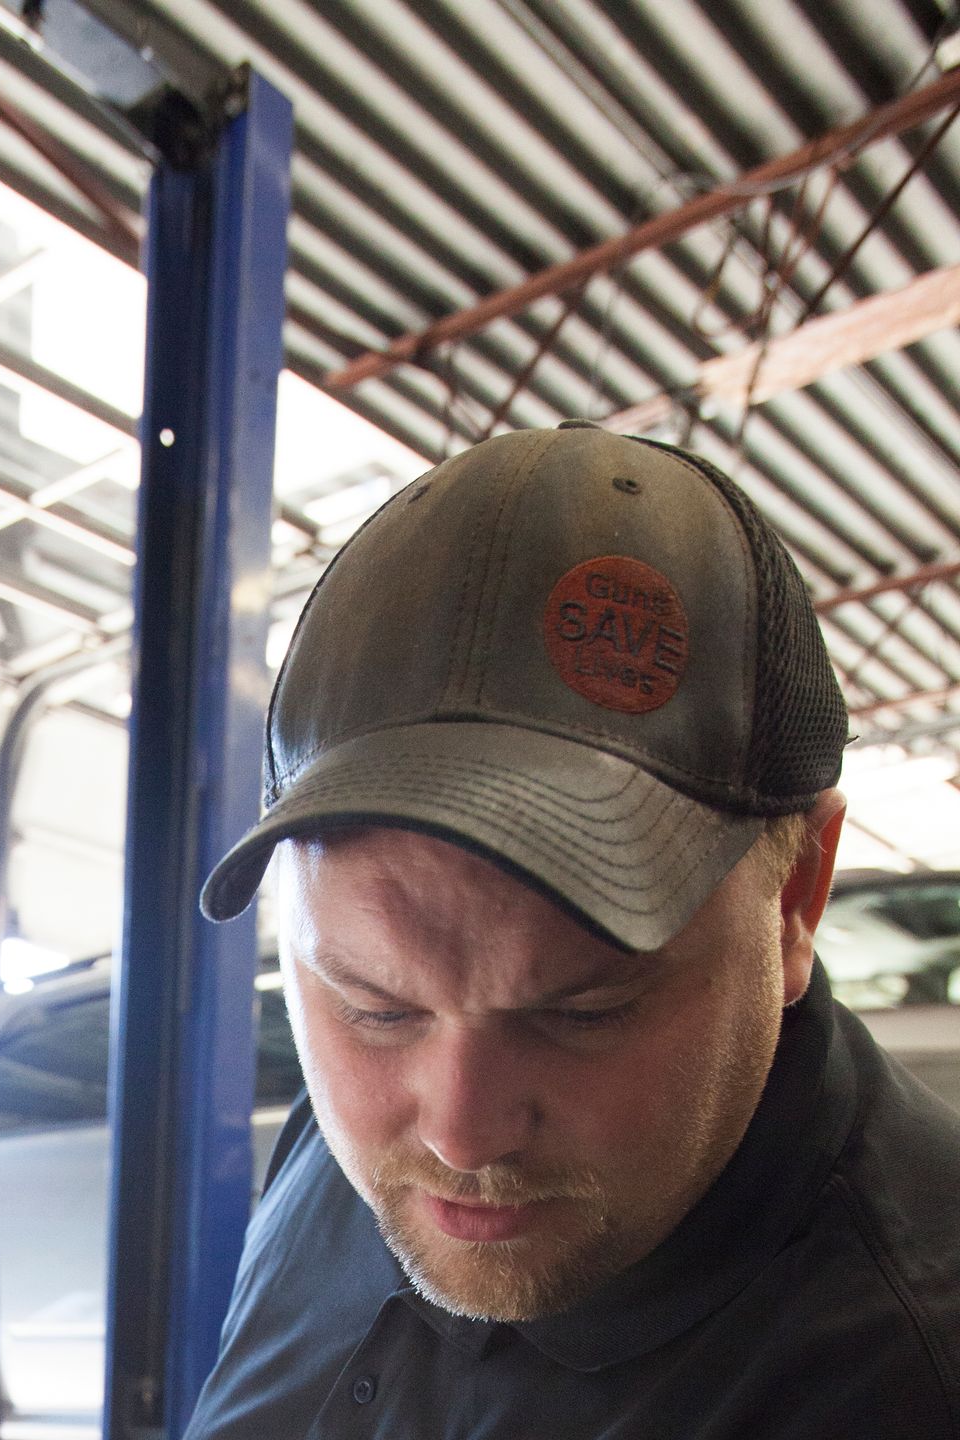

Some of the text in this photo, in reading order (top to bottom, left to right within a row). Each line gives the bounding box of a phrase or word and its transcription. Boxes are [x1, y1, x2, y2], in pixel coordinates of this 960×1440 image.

[585, 572, 674, 614] Guns
[556, 600, 686, 675] SAVE
[573, 645, 656, 695] Lives
